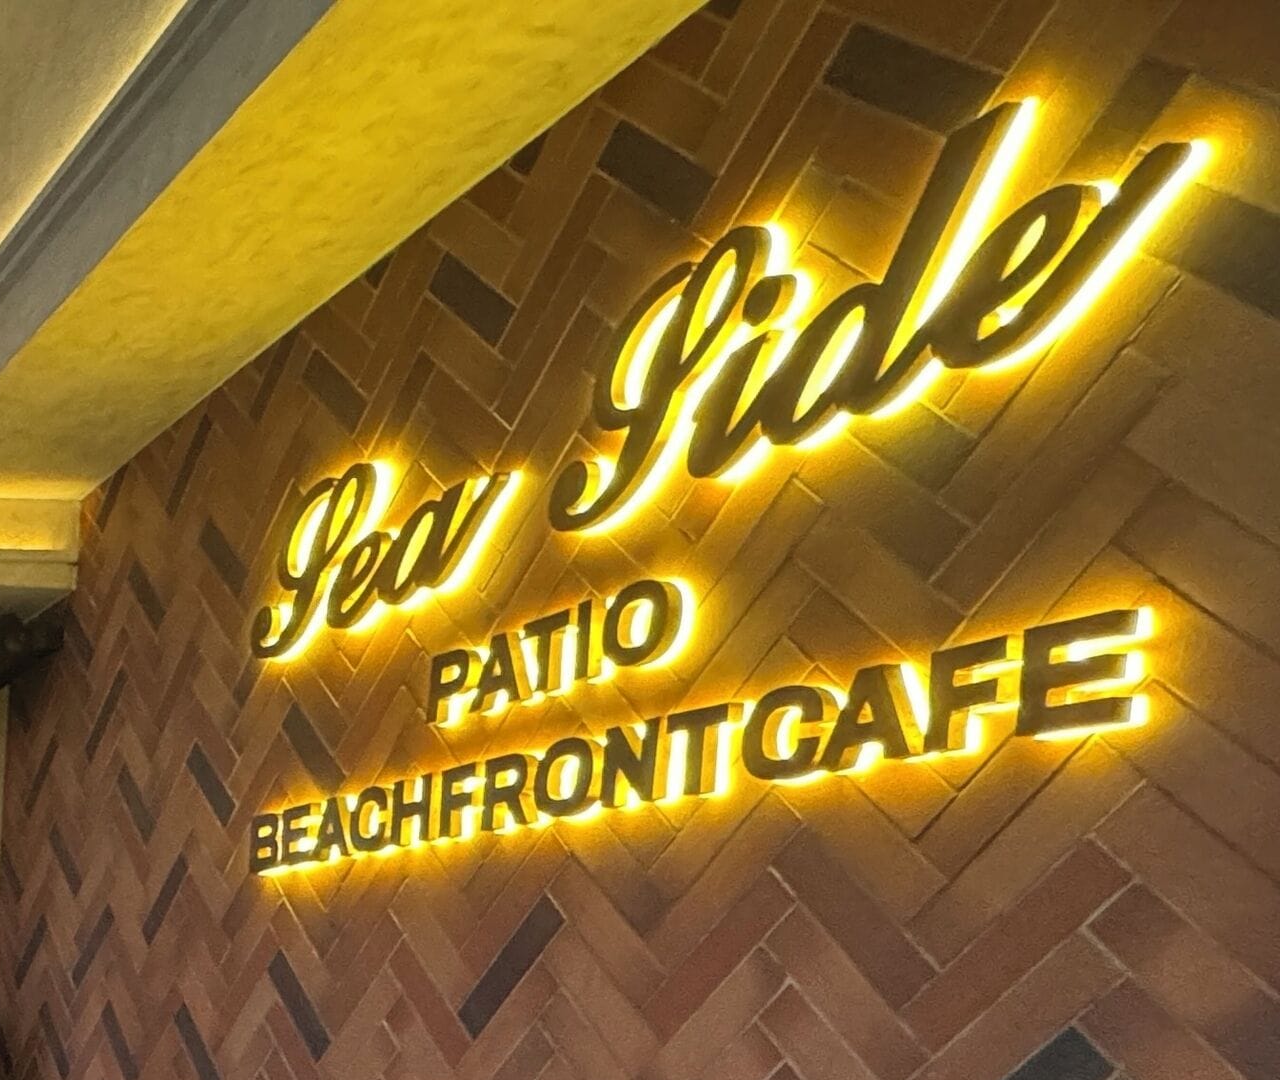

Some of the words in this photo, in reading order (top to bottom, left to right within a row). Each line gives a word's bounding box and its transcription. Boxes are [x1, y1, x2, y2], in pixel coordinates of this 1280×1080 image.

[250, 462, 516, 661] Sea
[549, 98, 1202, 534] Side
[249, 702, 734, 874] BEACHFRONT
[741, 606, 1148, 782] CAFE
[426, 579, 680, 726] PATIO
